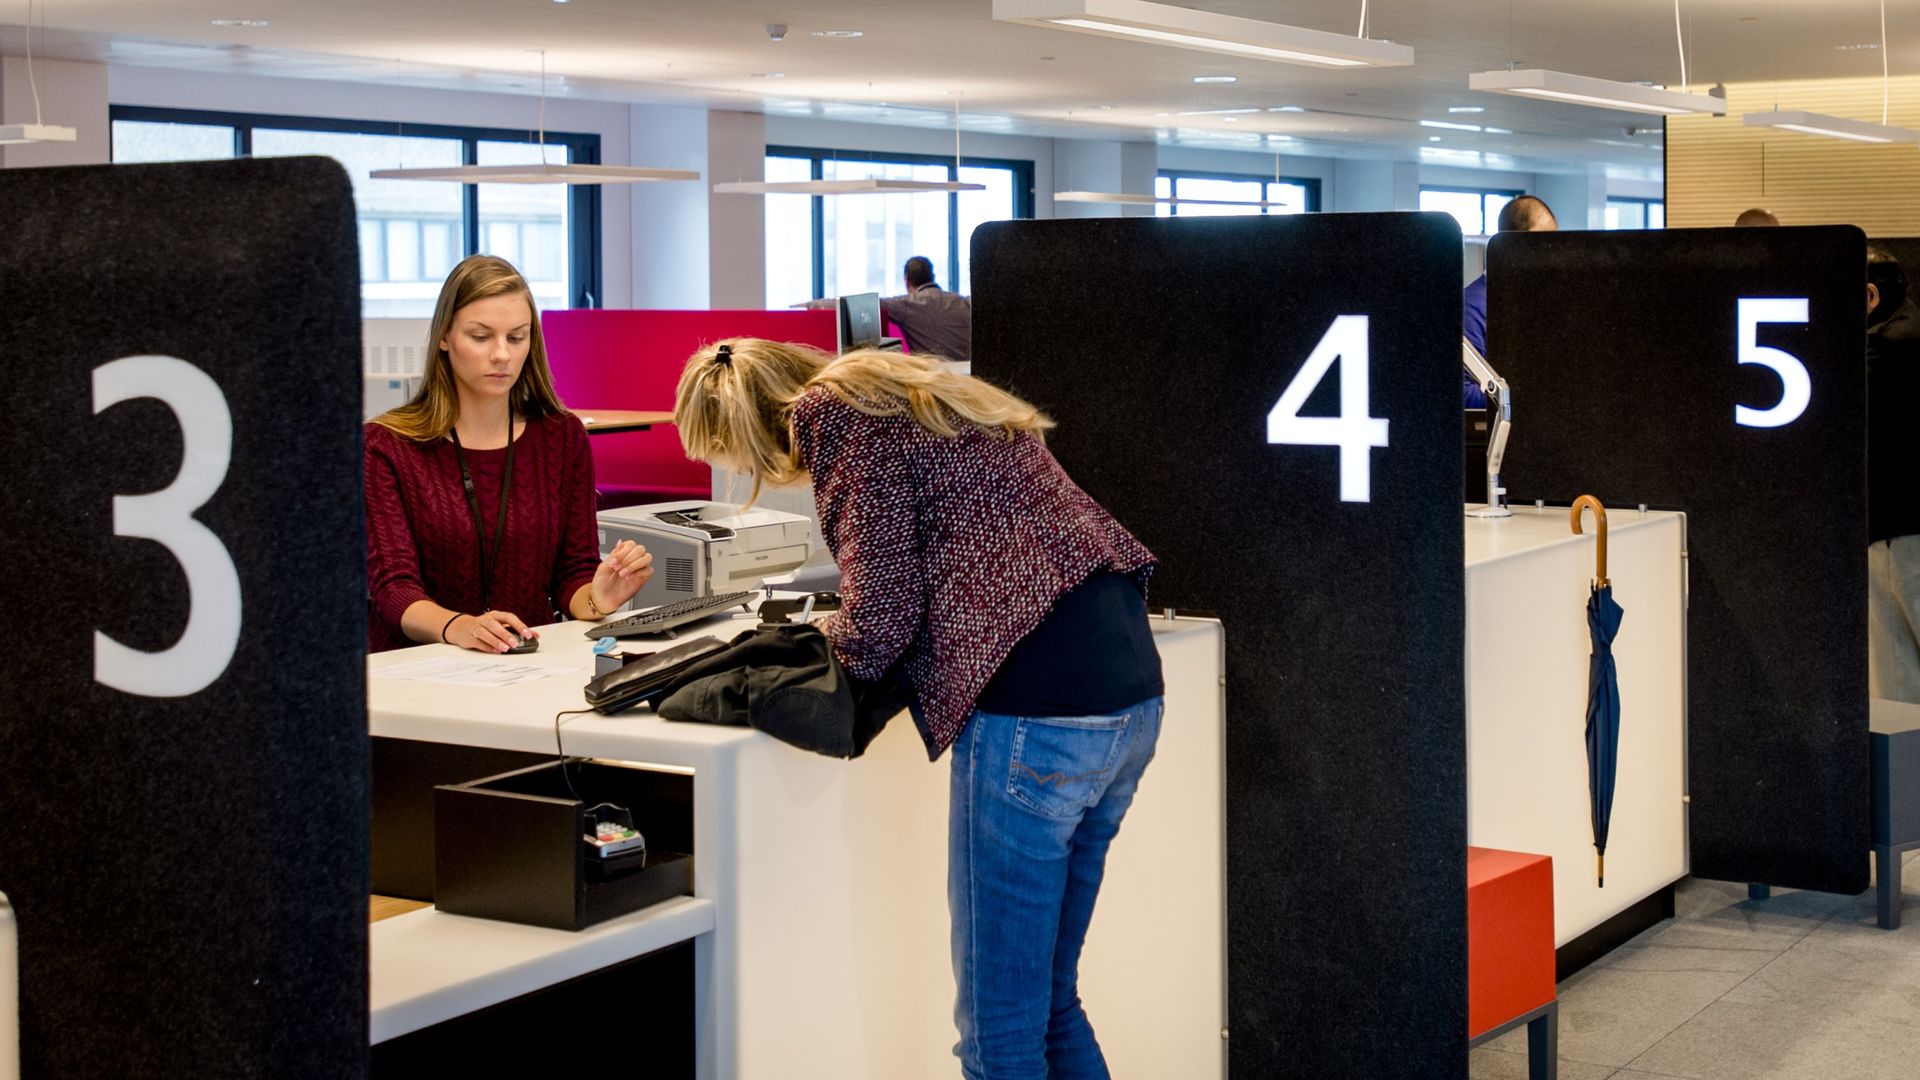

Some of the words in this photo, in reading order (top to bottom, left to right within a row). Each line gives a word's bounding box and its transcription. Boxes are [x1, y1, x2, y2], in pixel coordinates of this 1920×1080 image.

[1266, 315, 1390, 503] 4
[1735, 298, 1811, 427] 5
[93, 355, 242, 698] 3
